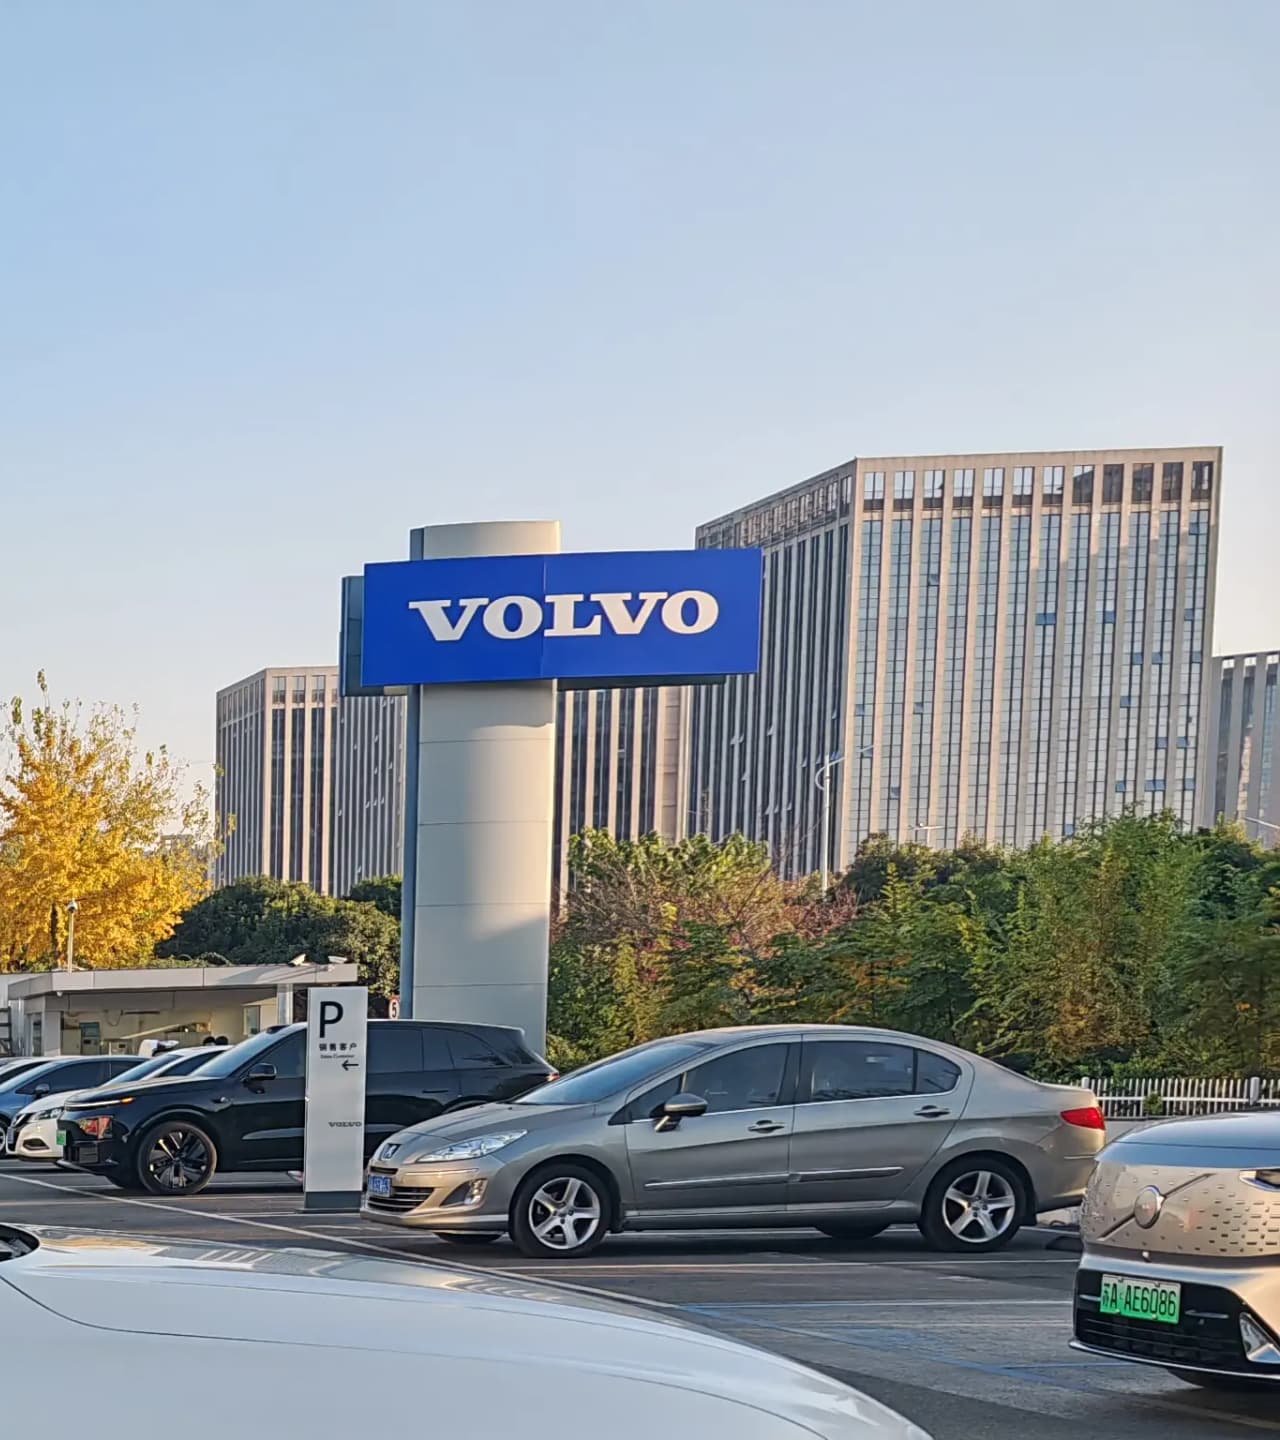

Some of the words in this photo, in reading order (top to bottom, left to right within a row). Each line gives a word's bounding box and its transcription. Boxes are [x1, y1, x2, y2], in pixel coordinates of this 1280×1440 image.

[409, 590, 719, 642] VOLVO
[319, 1001, 344, 1038] P
[391, 1002, 397, 1018] 5
